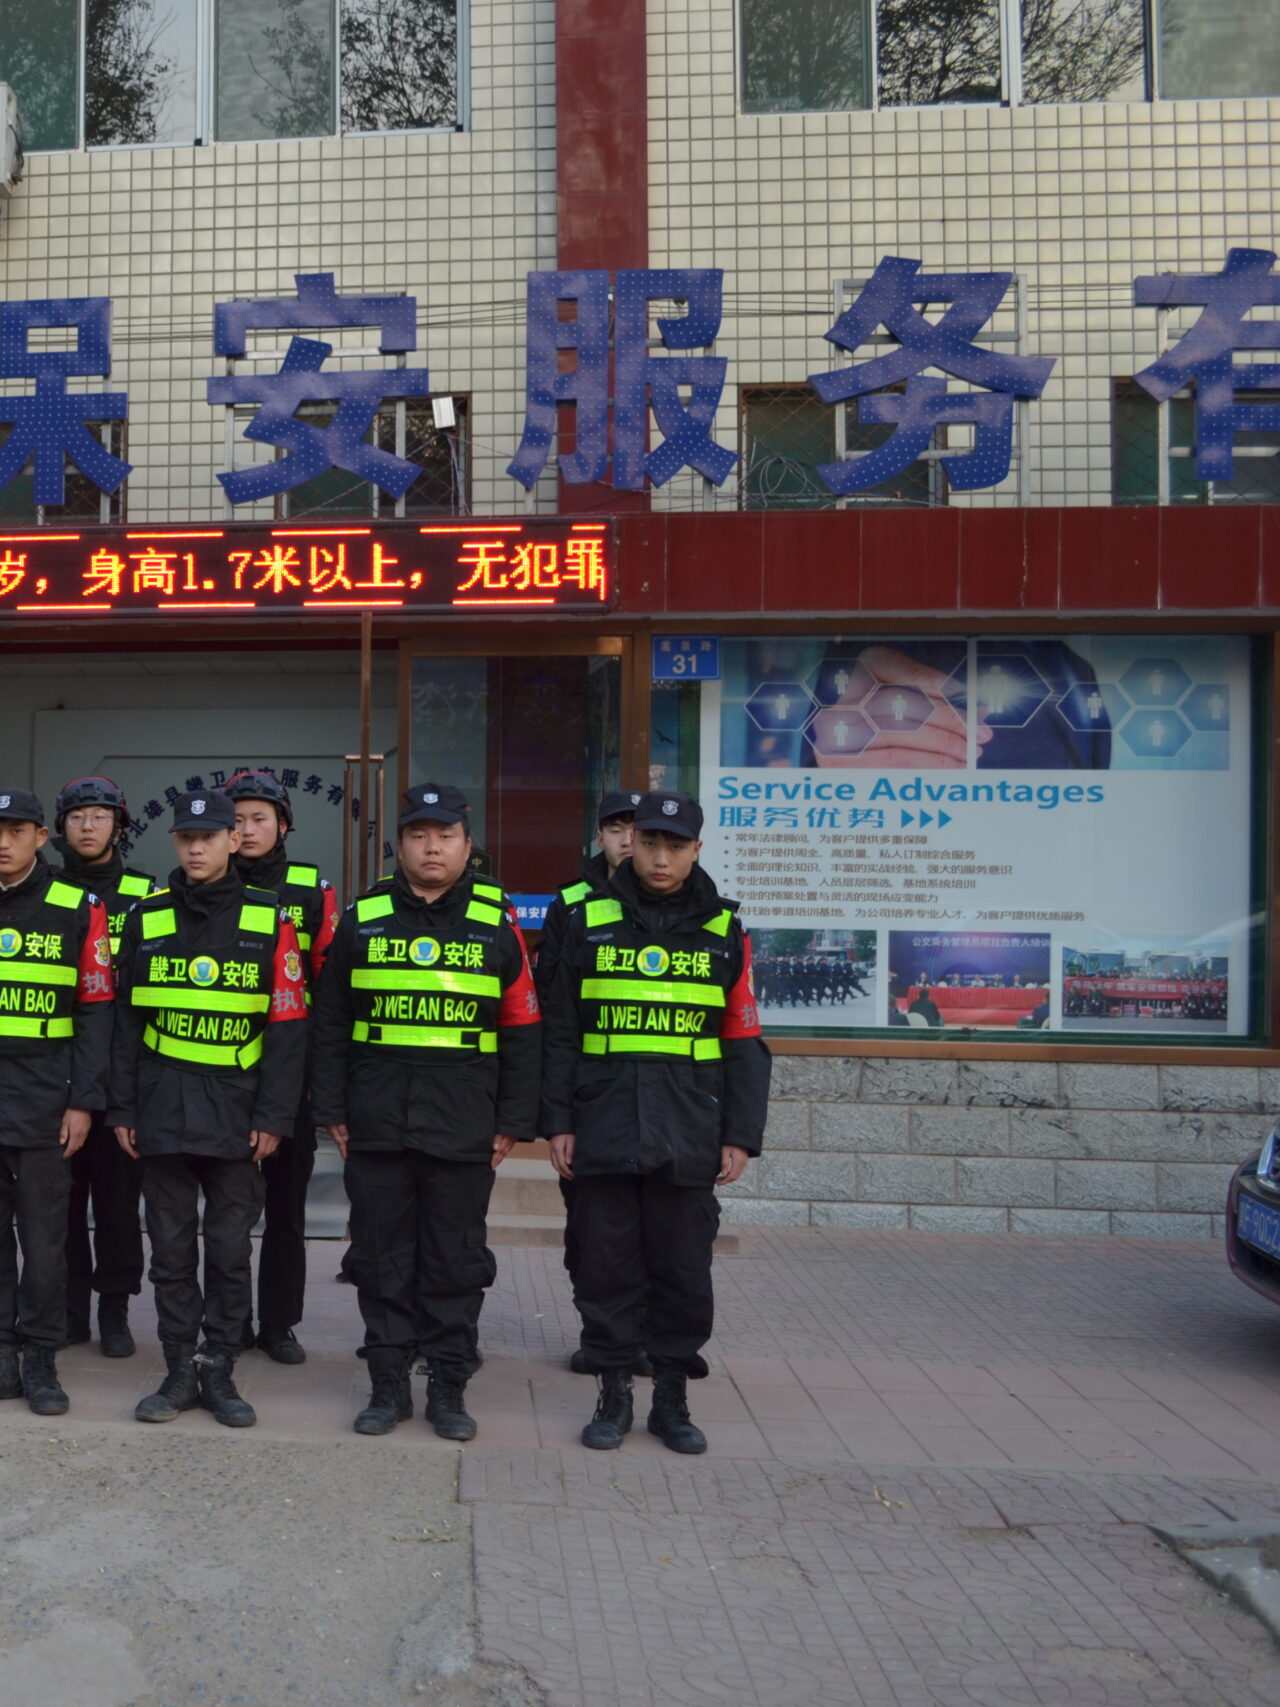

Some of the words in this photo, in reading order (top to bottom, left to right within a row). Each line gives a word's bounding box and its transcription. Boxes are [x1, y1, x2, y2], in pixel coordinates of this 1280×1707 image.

[672, 654, 697, 674] 31
[717, 776, 856, 801] Service
[869, 777, 1104, 810] Advantages
[718, 806, 885, 828] 服务优势
[25, 932, 62, 960] 安保
[368, 937, 407, 963] 畿卫
[444, 942, 484, 968] 安保
[149, 956, 187, 983] 畿卫
[223, 960, 260, 988] 安保
[596, 945, 635, 972] 畿卫
[671, 951, 711, 977] 安保
[24, 989, 56, 1013] BAO
[385, 996, 413, 1019] WEI
[416, 997, 440, 1021] AN
[444, 999, 478, 1022] BAO
[167, 1010, 193, 1037] WEI
[194, 1015, 219, 1040] AN
[221, 1018, 250, 1042] BAO
[597, 1006, 608, 1029] JI
[611, 1006, 642, 1029] WEI
[645, 1007, 670, 1031] AN
[674, 1009, 706, 1033] BAO
